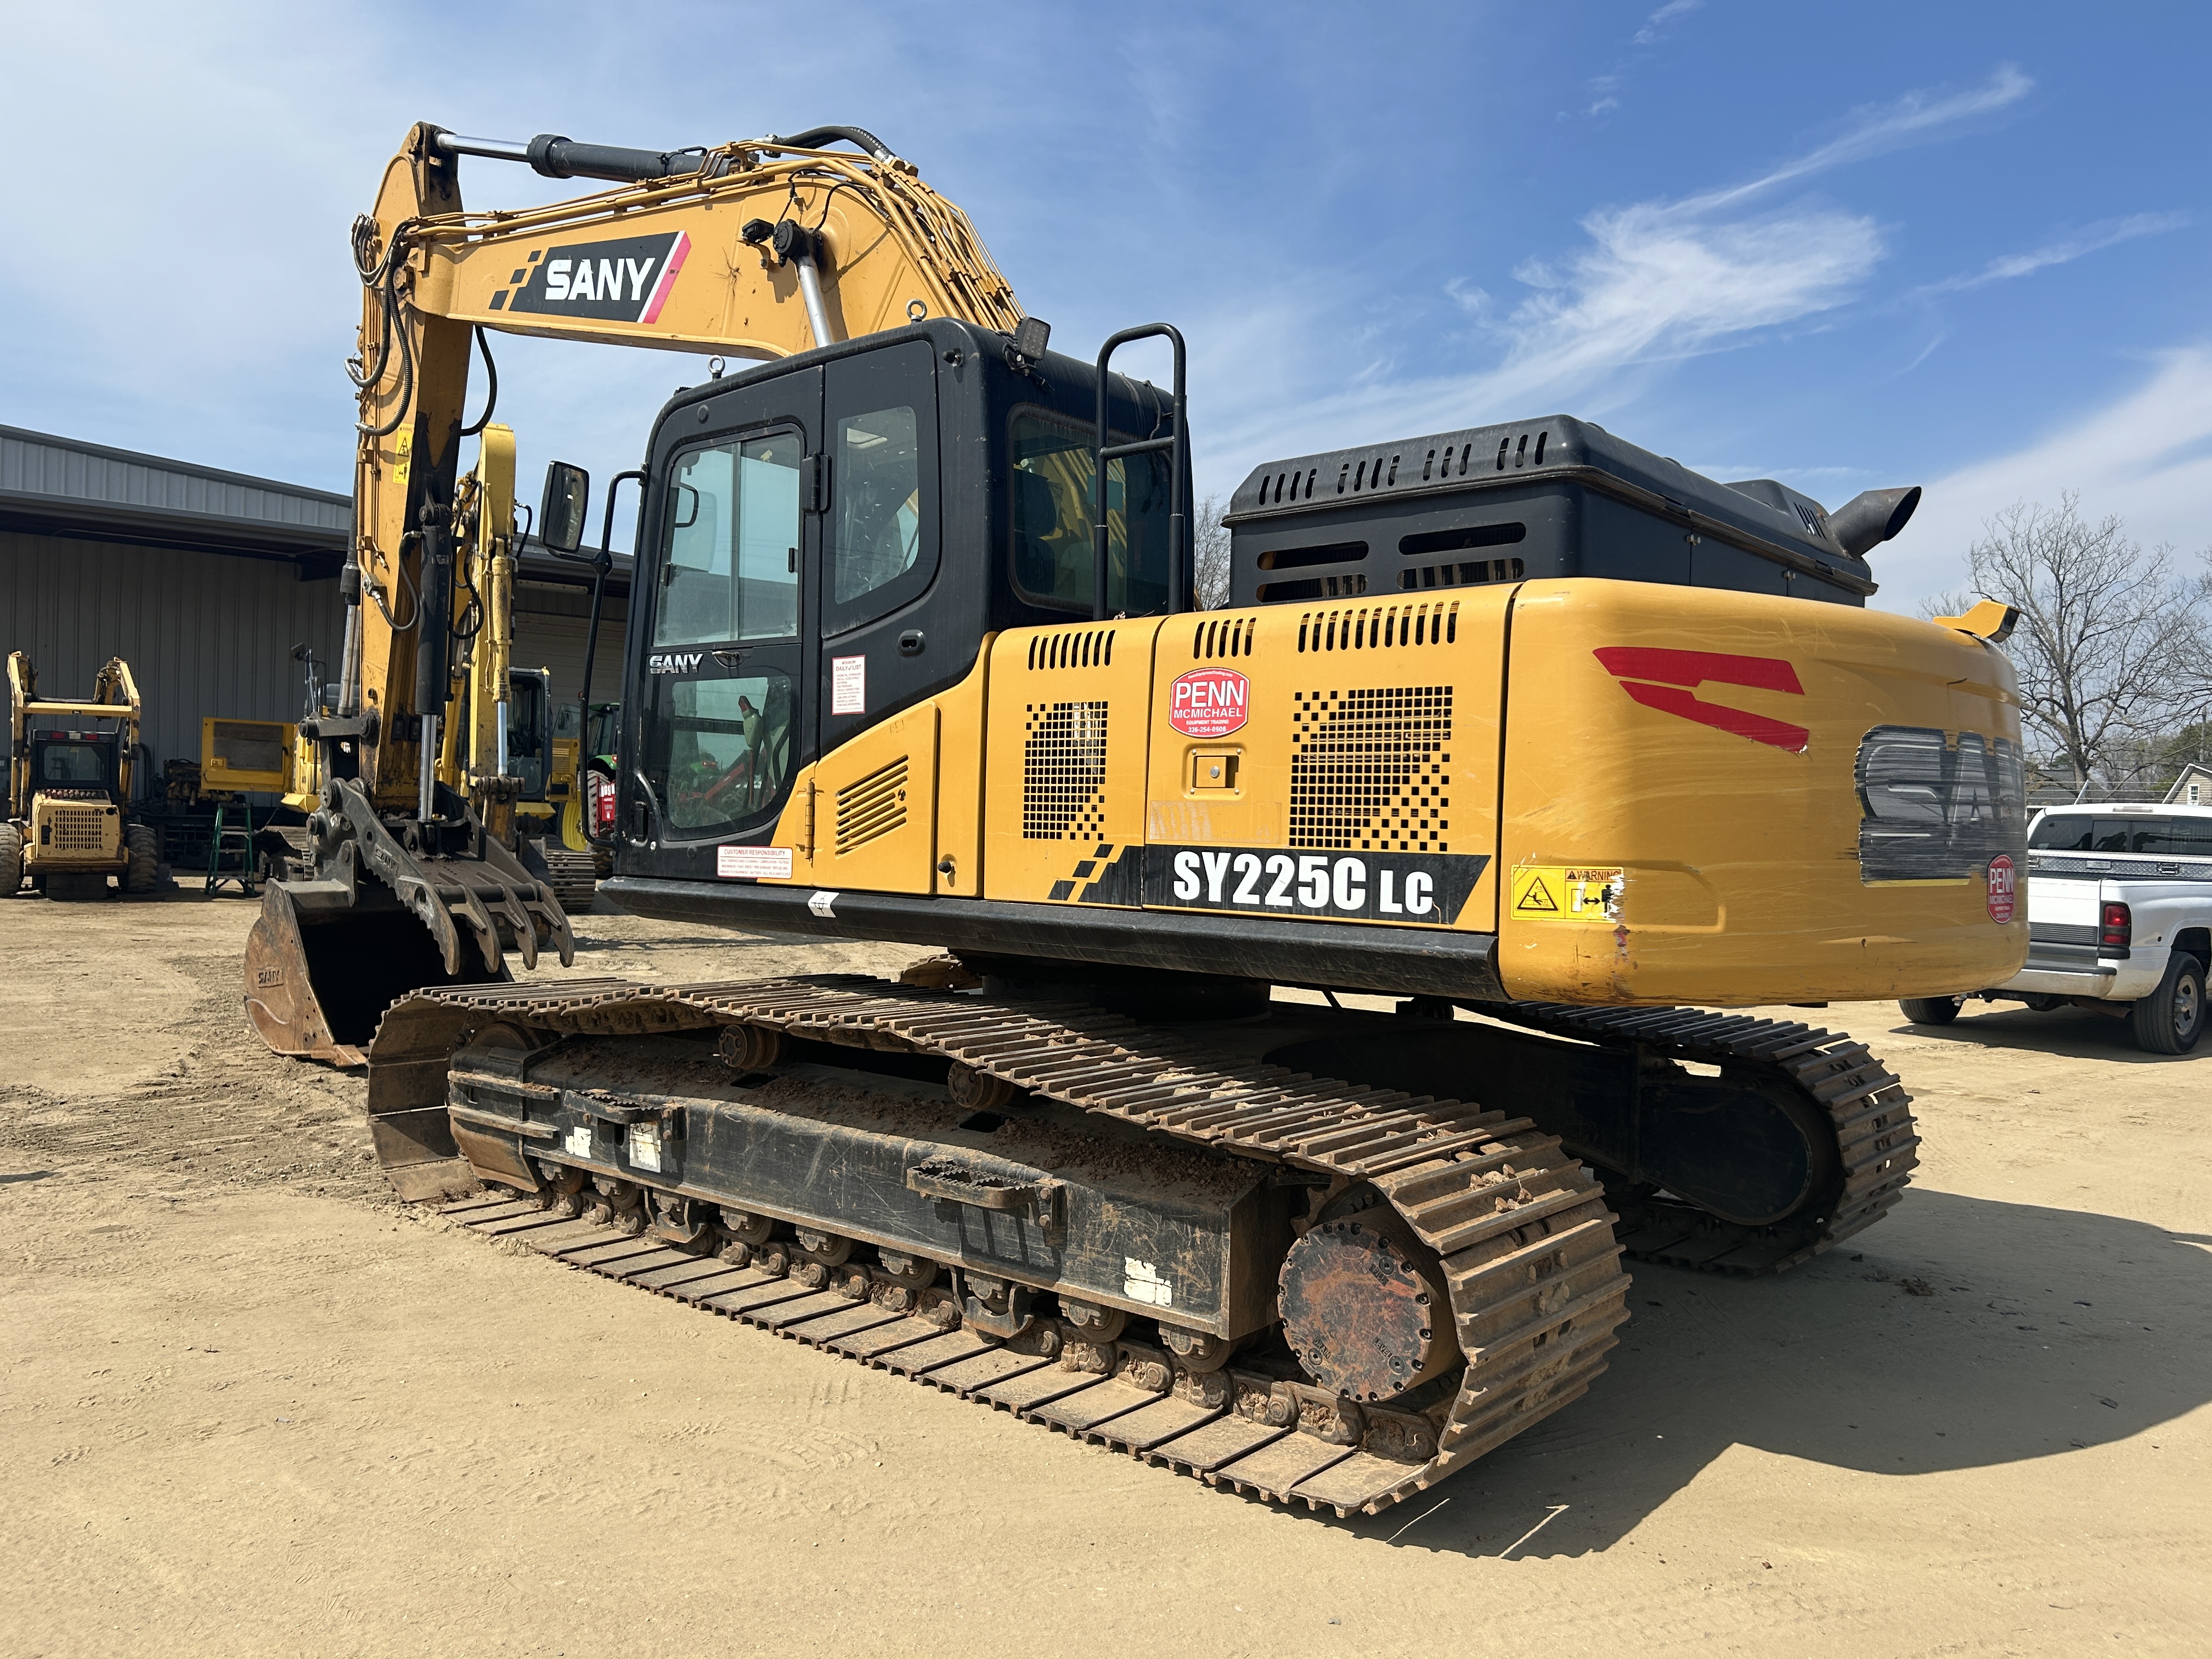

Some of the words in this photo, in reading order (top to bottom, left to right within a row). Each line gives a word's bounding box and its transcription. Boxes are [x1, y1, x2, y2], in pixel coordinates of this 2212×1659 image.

[545, 258, 656, 301] SANY
[650, 653, 703, 674] SANY
[1175, 680, 1245, 708] PENN
[1173, 707, 1243, 719] MCMICHAEL
[1172, 851, 1367, 911] SY225C
[1380, 870, 1434, 915] LC
[1990, 868, 2013, 894] PENN
[258, 970, 280, 984] SANY
[1372, 1266, 1386, 1284] FILL
[1313, 1338, 1331, 1358] DRAIN
[1373, 1338, 1392, 1359] LEVEL
